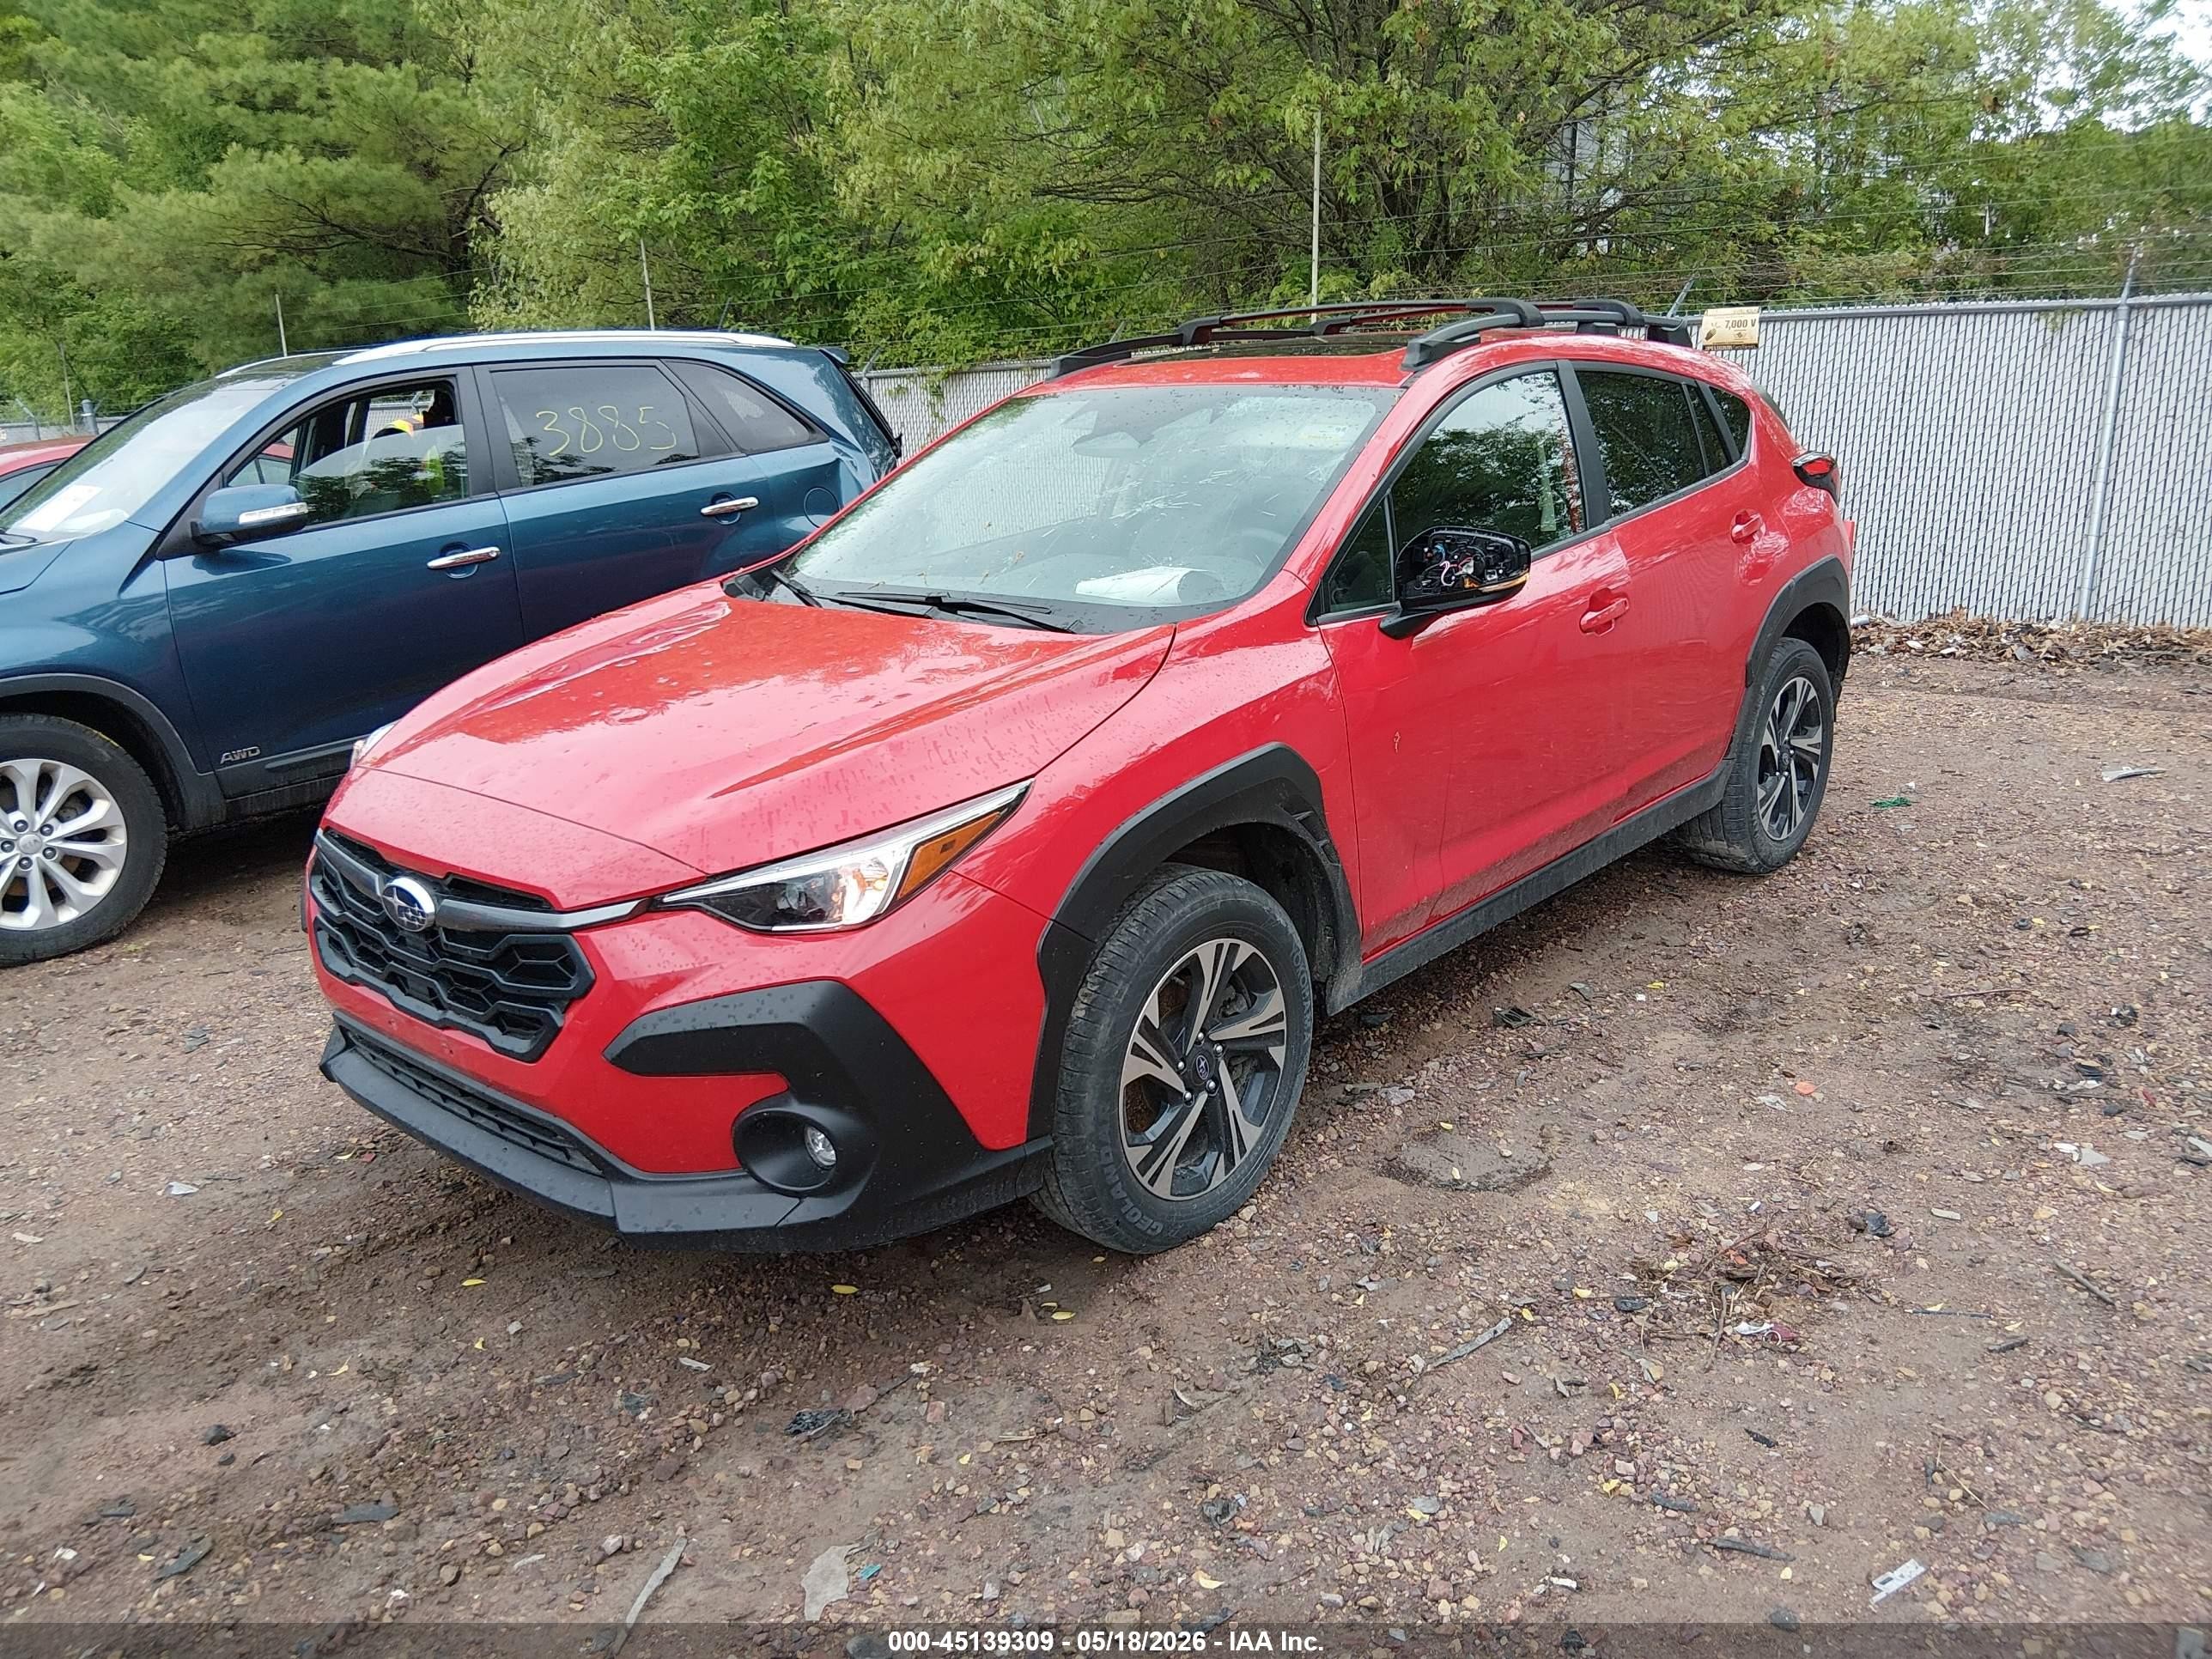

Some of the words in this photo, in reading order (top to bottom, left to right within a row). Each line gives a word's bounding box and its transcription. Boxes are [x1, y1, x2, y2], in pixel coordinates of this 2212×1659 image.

[1725, 319, 1748, 330] 7,000
[1751, 318, 1757, 327] V
[536, 405, 677, 457] 3885
[220, 746, 260, 764] AWD
